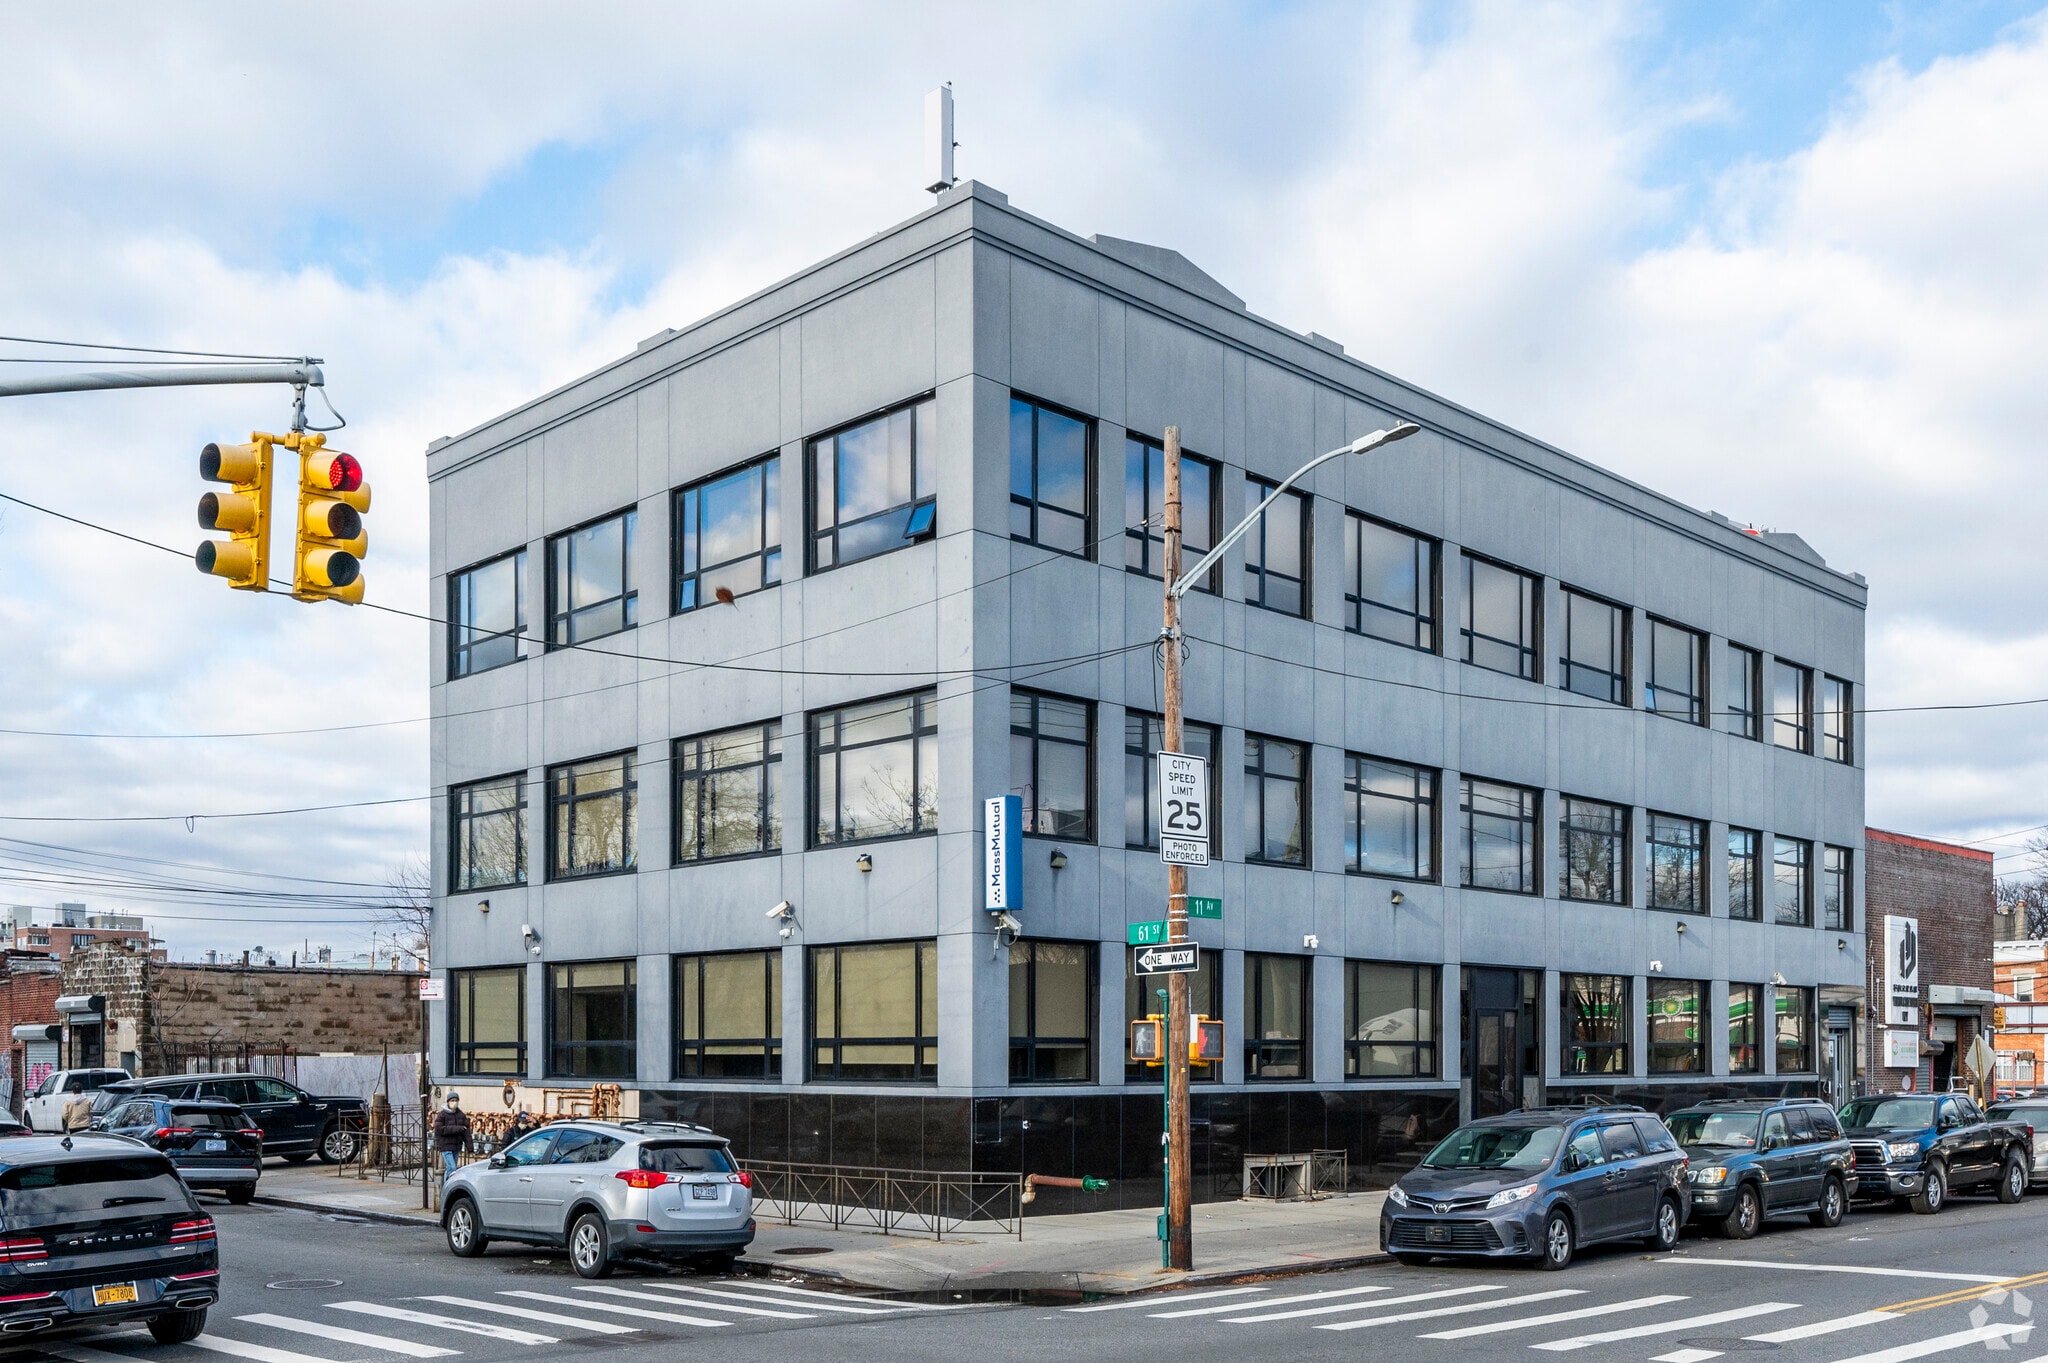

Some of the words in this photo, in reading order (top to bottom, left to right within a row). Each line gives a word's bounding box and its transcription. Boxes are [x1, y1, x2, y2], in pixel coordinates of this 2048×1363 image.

[1172, 760, 1191, 770] CITY
[1168, 772, 1196, 784] SPEED
[1172, 785, 1193, 796] LIMIT
[1167, 799, 1202, 831] 25
[991, 801, 1001, 887] MassMutual
[1172, 842, 1197, 852] PHOTO
[1165, 851, 1205, 862] ENFORCED
[1195, 899, 1203, 915] 11
[1138, 925, 1149, 941] 61
[1152, 924, 1160, 934] St
[1144, 954, 1162, 965] ONE
[1170, 952, 1190, 964] WAY
[69, 1232, 153, 1245] GENESIS
